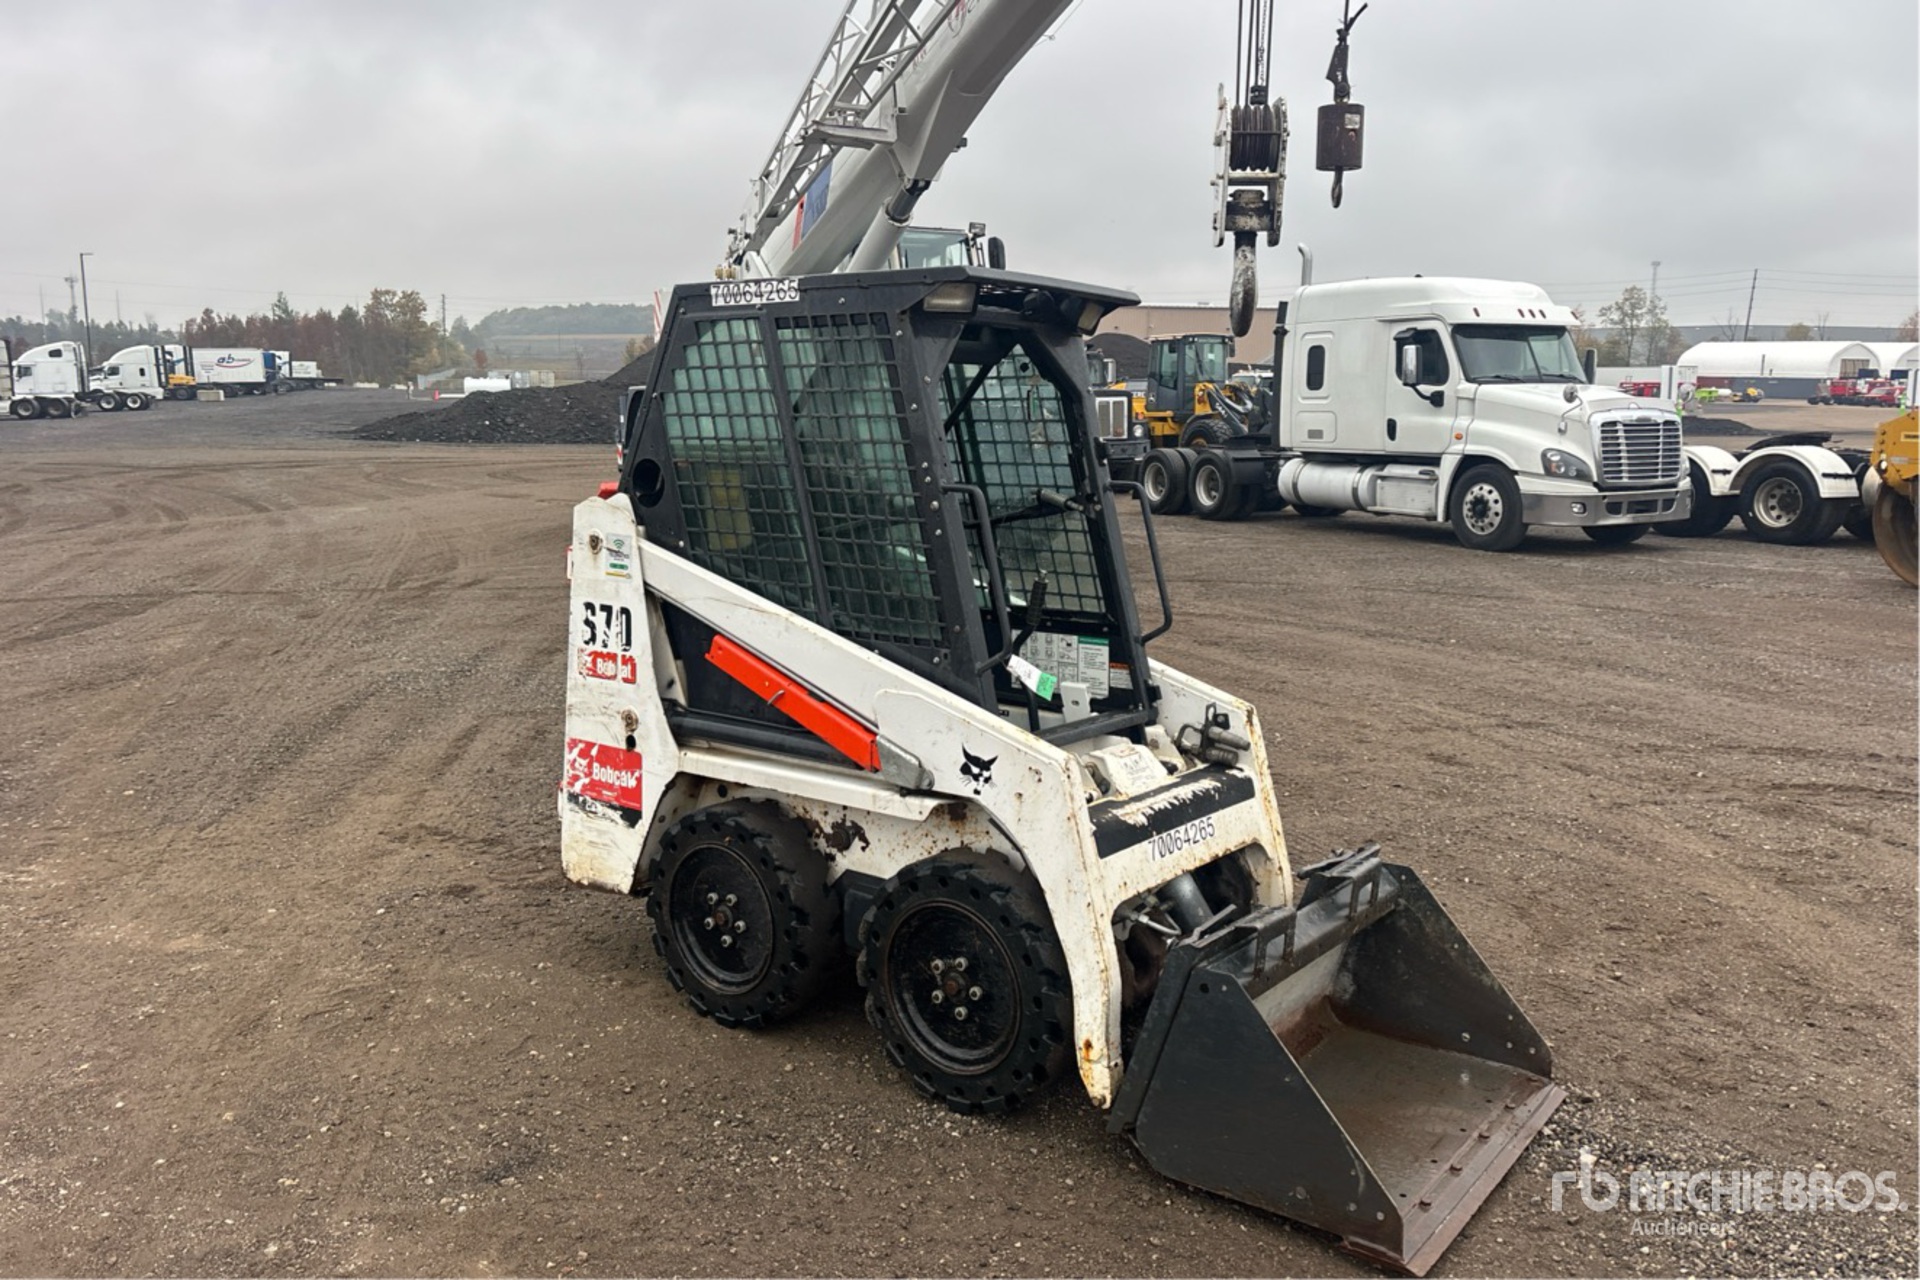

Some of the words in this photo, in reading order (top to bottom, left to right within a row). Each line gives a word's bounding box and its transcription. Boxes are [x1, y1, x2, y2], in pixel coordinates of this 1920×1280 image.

[712, 280, 798, 305] 70064265
[582, 601, 632, 653] S70
[1148, 816, 1215, 862] 70064265
